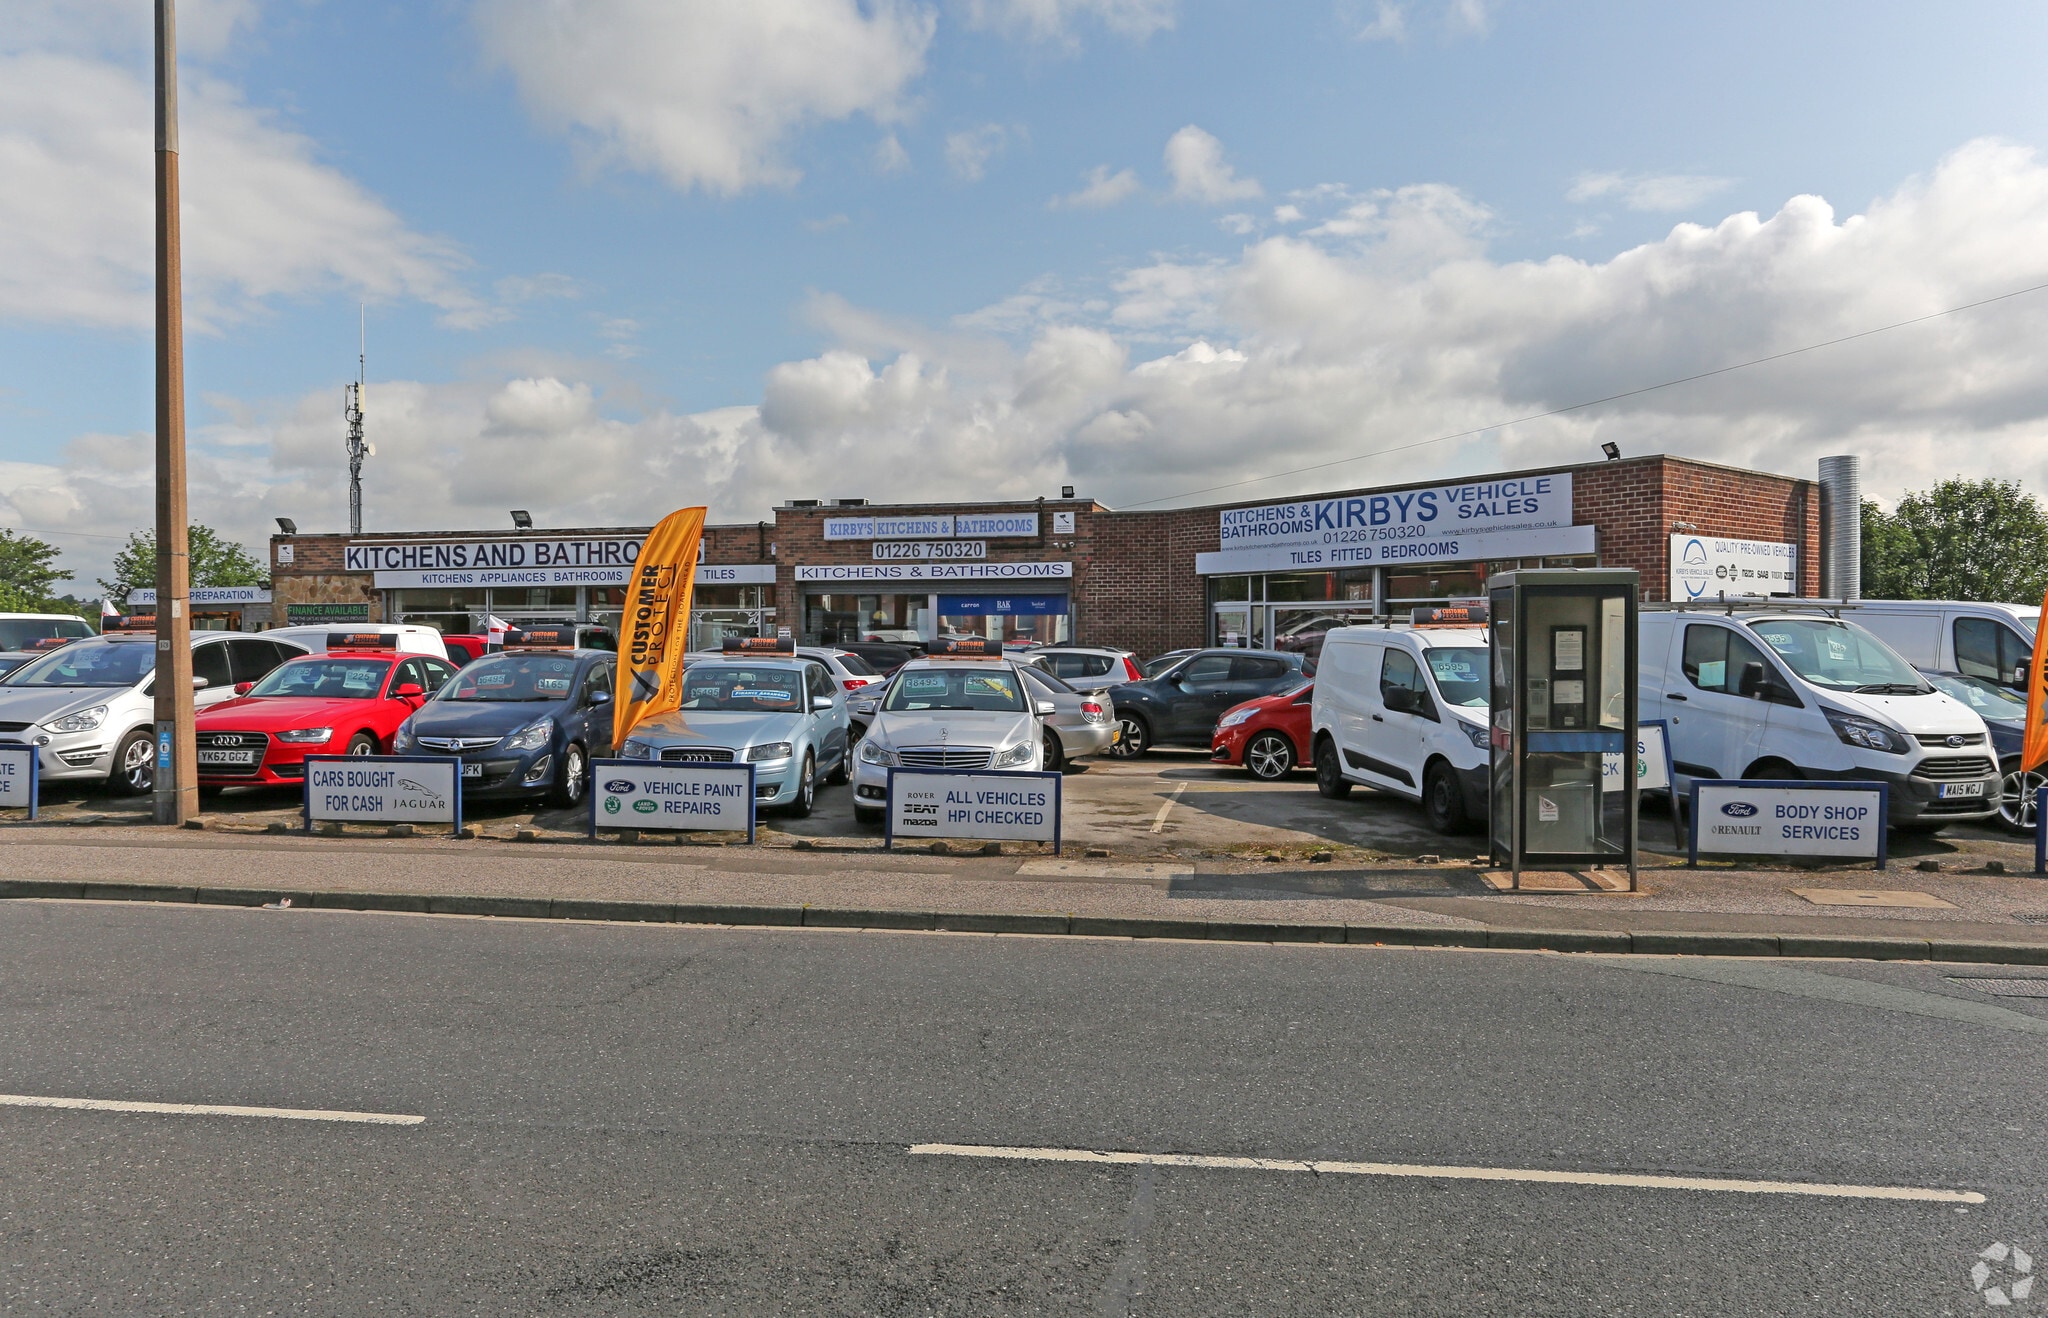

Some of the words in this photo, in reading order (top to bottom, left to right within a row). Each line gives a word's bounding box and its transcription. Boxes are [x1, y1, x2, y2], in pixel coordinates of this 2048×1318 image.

[1444, 478, 1551, 503] VEHICLE
[1223, 506, 1296, 525] KITCHENS
[1300, 504, 1310, 517] &
[1314, 492, 1438, 530] KIRBYS
[1458, 498, 1538, 519] SALES
[830, 522, 873, 536] KIRBY'S
[877, 521, 938, 534] KITCHENS
[940, 520, 950, 534] &
[956, 519, 1032, 534] BATHROOMS
[1222, 520, 1314, 540] BATHROOMS
[1323, 529, 1366, 544] 01226
[1370, 524, 1426, 540] 750320
[346, 545, 467, 570] KITCHENS
[473, 544, 526, 567] AND
[876, 543, 920, 558] 01226
[926, 542, 982, 557] 750320
[1290, 550, 1322, 564] TILES
[1331, 547, 1372, 562] FITTED
[1382, 541, 1458, 559] BEDROOMS
[422, 574, 472, 584] KITCHENS
[480, 572, 546, 582] APPLIANCES
[554, 571, 622, 582] BATHROOMS
[704, 569, 735, 580] TILES
[801, 566, 902, 578] KITCHENS
[910, 566, 923, 577] &
[932, 564, 1065, 577] BATHROOMS
[190, 590, 254, 600] PREPARATION
[288, 606, 323, 615] FINANCE
[325, 606, 368, 615] AVAILABLE
[631, 564, 660, 665] CUSTOMER
[648, 564, 673, 665] PROTECT
[202, 752, 226, 761] YK62
[228, 752, 248, 761] GGZ
[313, 771, 344, 787] CARS
[347, 771, 395, 787] BOUGHT
[610, 781, 630, 792] Ford
[644, 782, 700, 796] VEHICLE
[704, 784, 742, 797] PAINT
[326, 795, 348, 811] FOR
[352, 795, 383, 812] CASH
[394, 799, 445, 809] JAGUAR
[946, 791, 972, 804] ALL
[976, 791, 1046, 806] VEHICLES
[664, 801, 720, 815] REPAIRS
[904, 804, 939, 814] SEAT
[1728, 804, 1751, 816] Ford
[1776, 805, 1820, 819] BODY
[1824, 806, 1868, 820] SHOP
[948, 810, 970, 823] HPI
[975, 810, 1043, 825] CHECKED
[1718, 826, 1762, 836] RENAULT
[1782, 825, 1860, 840] SERVICES
